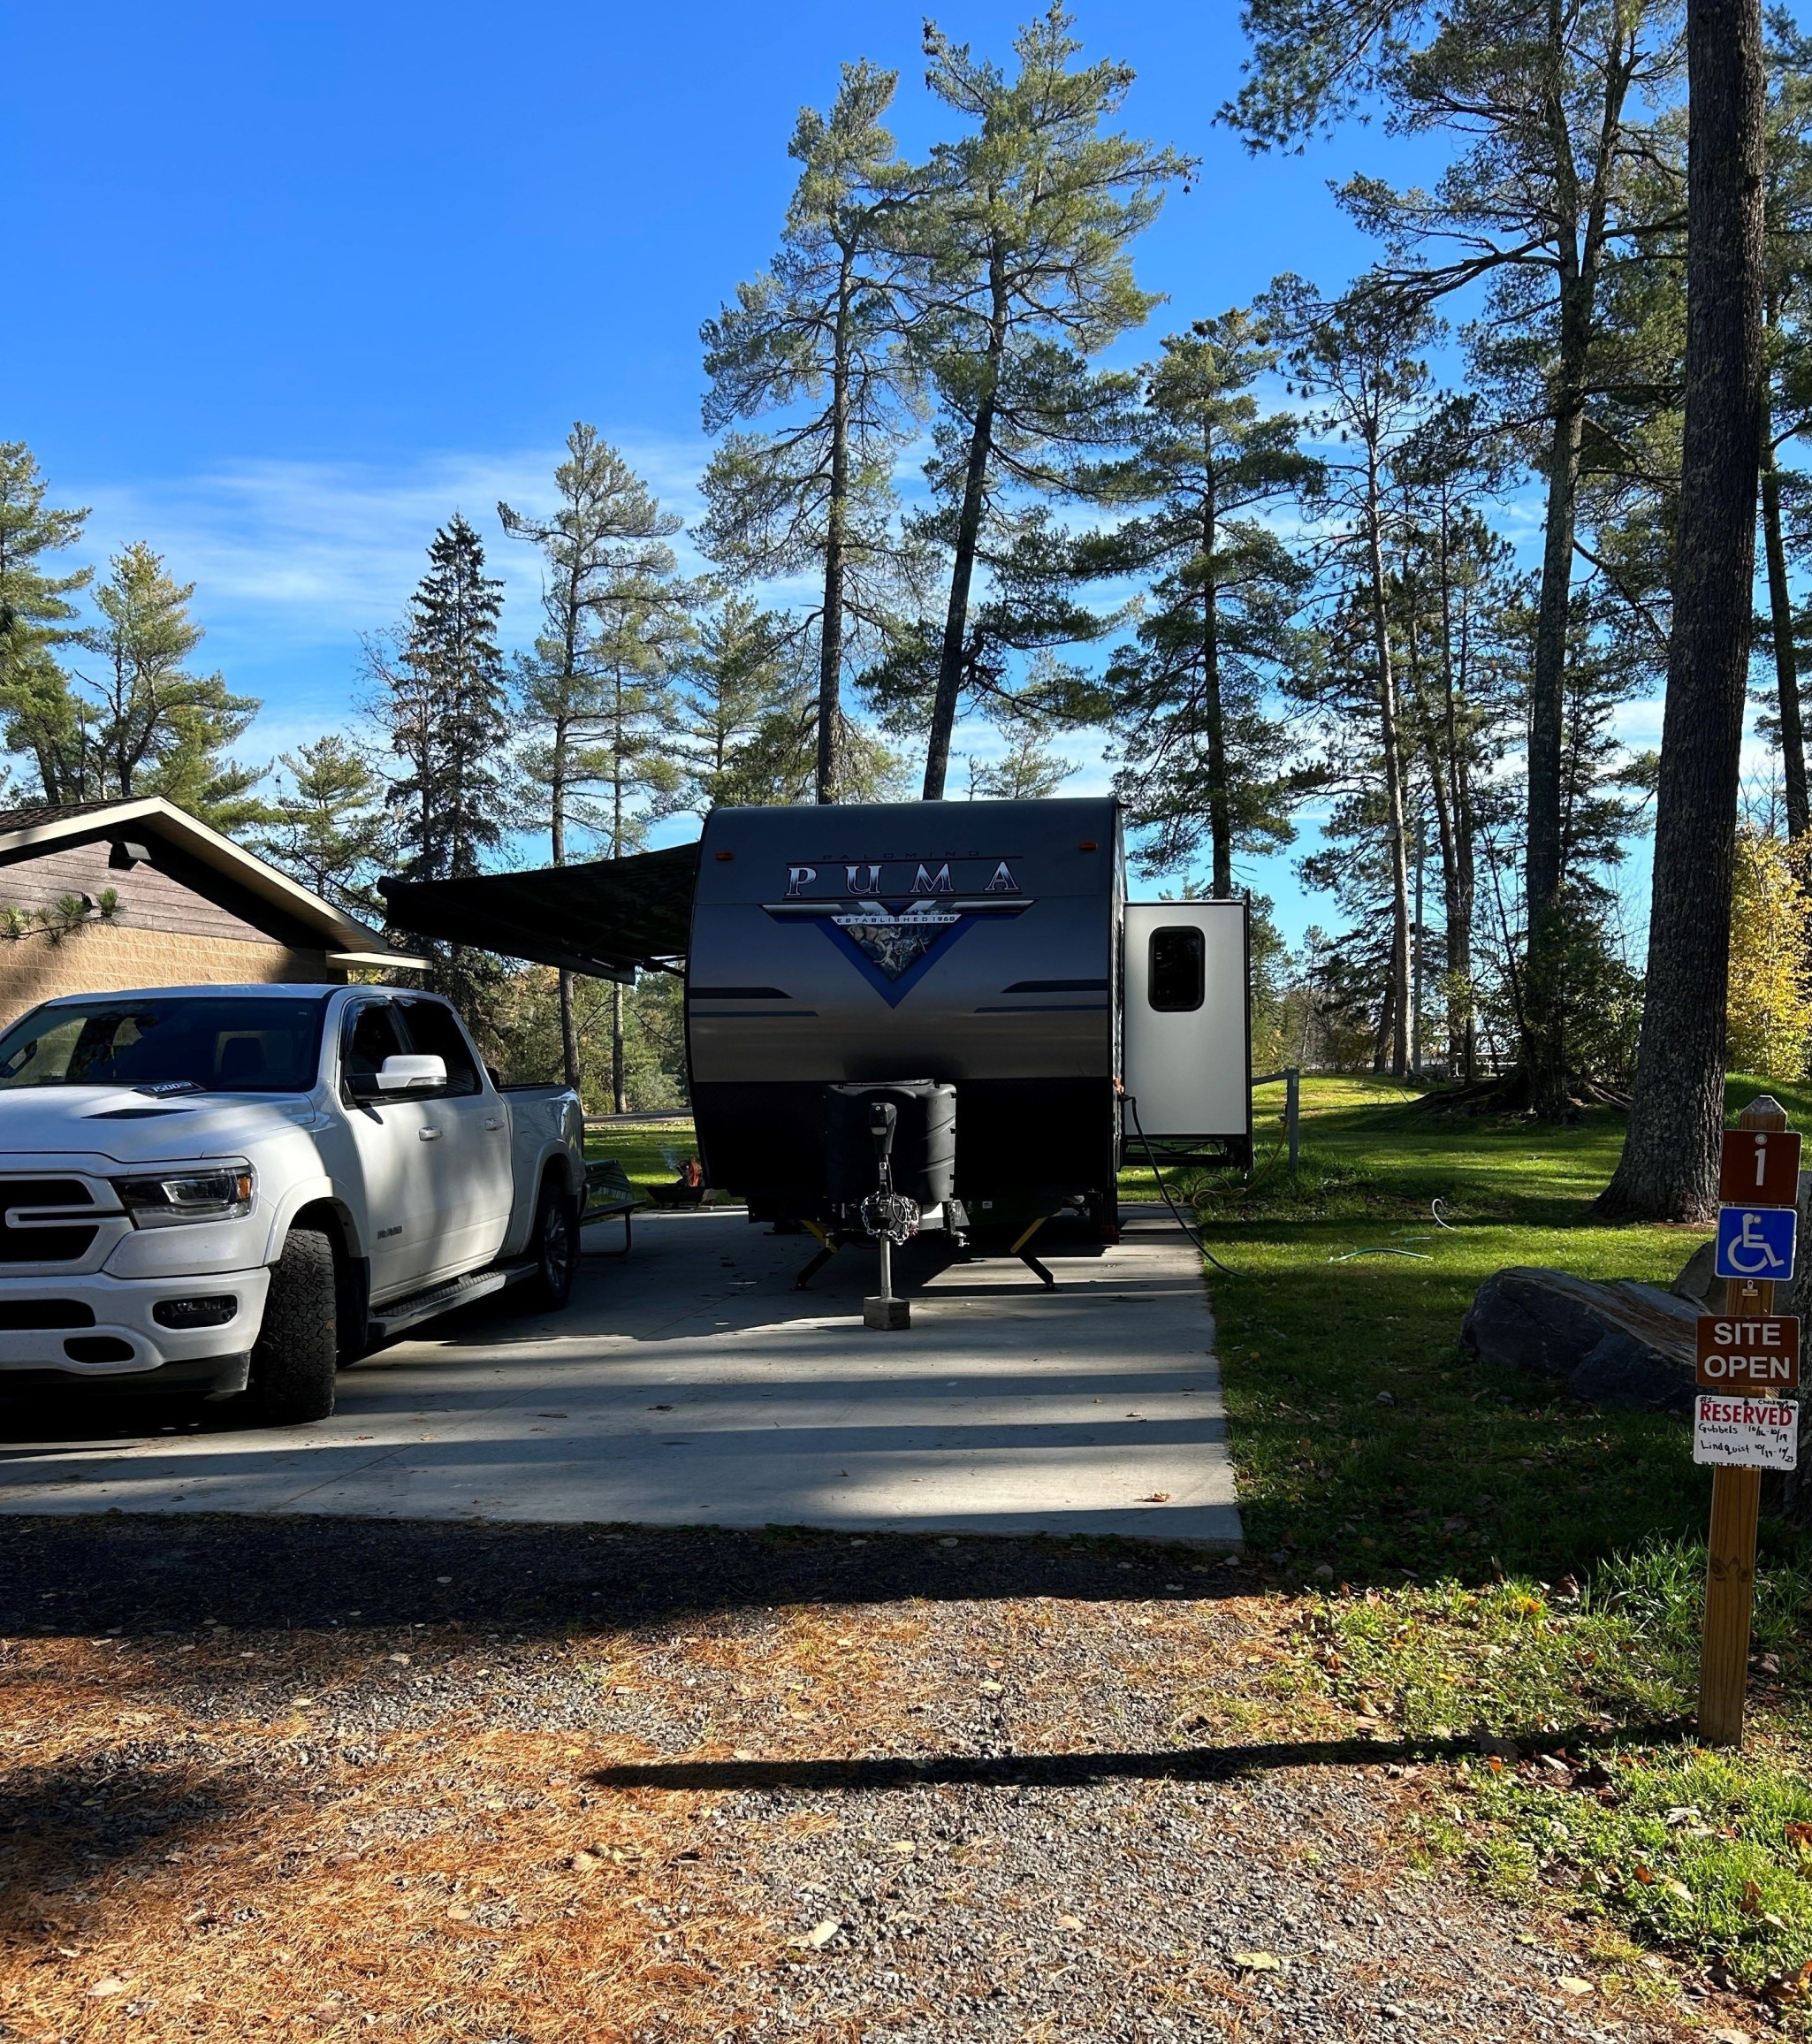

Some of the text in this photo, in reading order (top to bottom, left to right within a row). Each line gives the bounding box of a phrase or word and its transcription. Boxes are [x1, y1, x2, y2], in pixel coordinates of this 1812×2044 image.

[822, 850, 979, 861] PALOMINO
[784, 860, 1021, 896] PUMA
[151, 1083, 180, 1092] 1500
[1755, 1148, 1766, 1186] 1
[377, 1225, 402, 1239] RAM
[1713, 1322, 1781, 1346] SITE
[1704, 1354, 1790, 1379] OPEN
[1700, 1403, 1793, 1426] RESERVED
[1700, 1440, 1750, 1455] Lindquist
